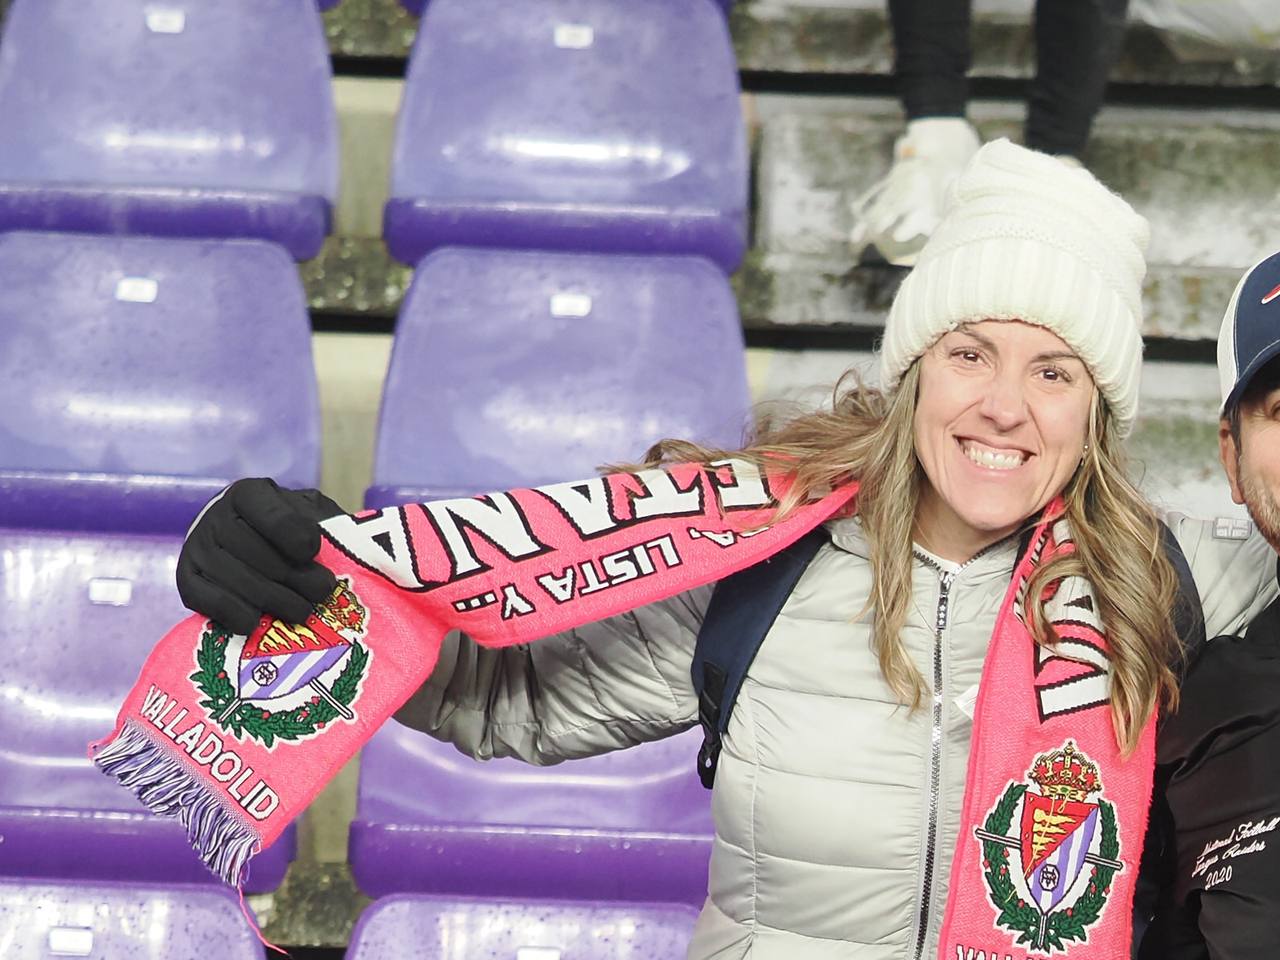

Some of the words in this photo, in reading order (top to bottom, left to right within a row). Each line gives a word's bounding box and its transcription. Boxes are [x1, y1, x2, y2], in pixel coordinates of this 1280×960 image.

[535, 533, 683, 604] LISTA
[140, 683, 280, 822] VALLADOLID
[1204, 864, 1233, 891] 2020
